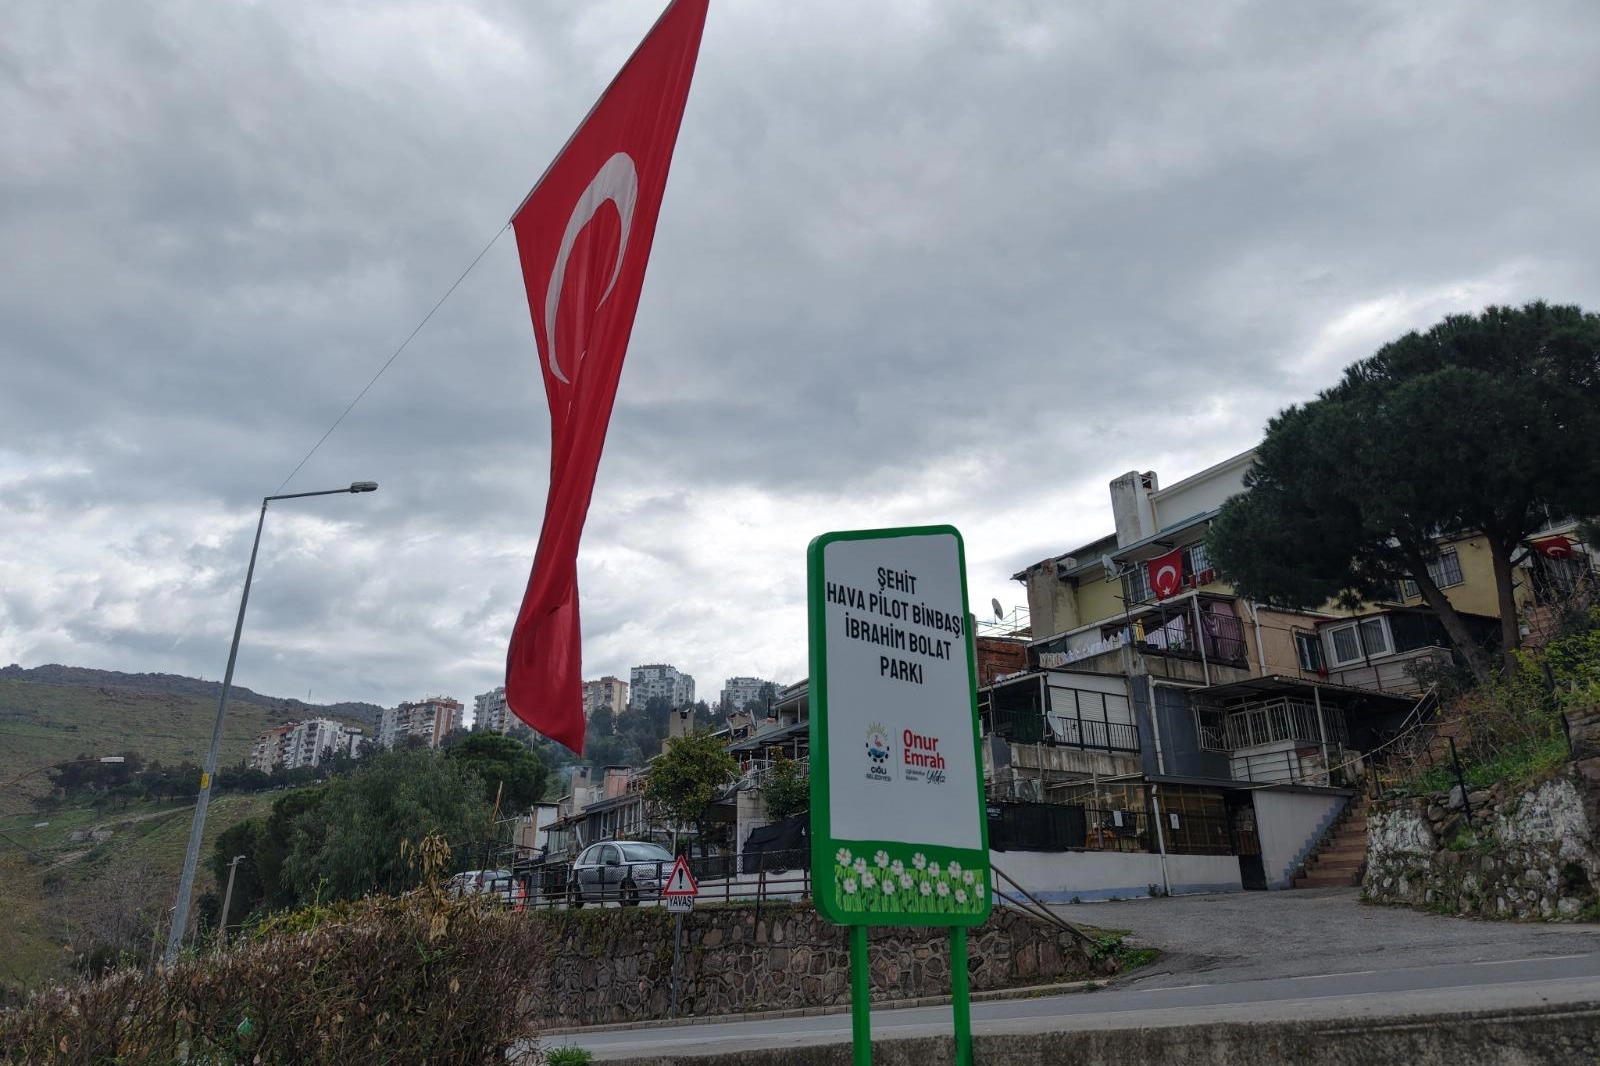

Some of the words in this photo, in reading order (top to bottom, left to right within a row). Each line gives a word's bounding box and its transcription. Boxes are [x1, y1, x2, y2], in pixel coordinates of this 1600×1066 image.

[877, 567, 917, 595] ŞEHİT
[827, 582, 866, 611] HAVA
[869, 591, 909, 621] PİLOT
[912, 602, 965, 639] BİNBAŞI
[845, 612, 906, 650] İBRAHİM
[908, 632, 951, 660] BOLAT
[880, 656, 923, 684] PARKI
[903, 729, 939, 751] Onur
[904, 748, 945, 770] Emrah
[669, 895, 692, 910] YAVAŞ
